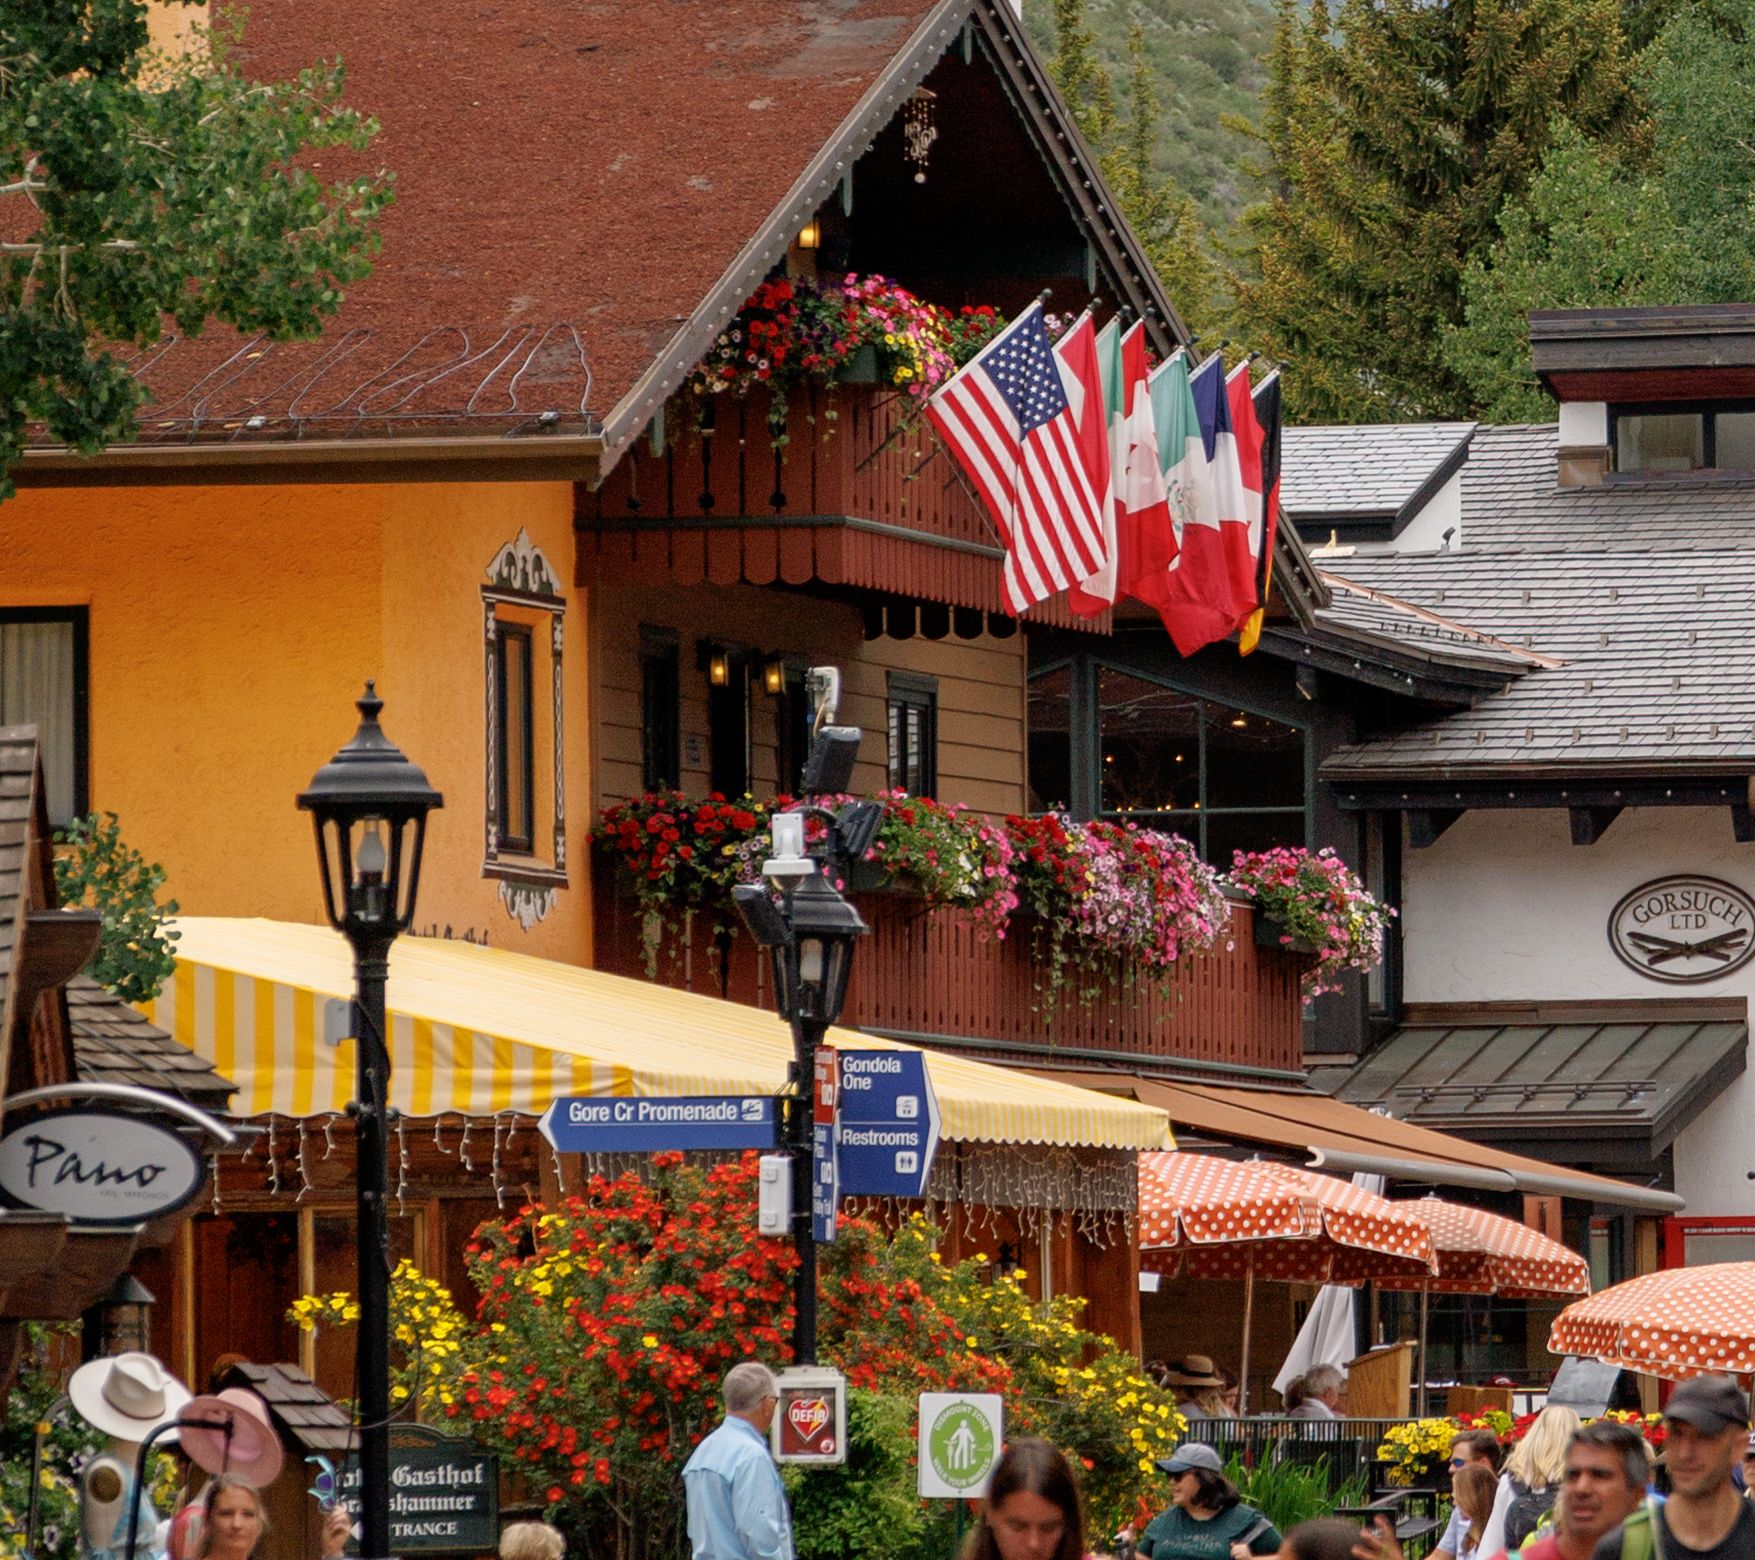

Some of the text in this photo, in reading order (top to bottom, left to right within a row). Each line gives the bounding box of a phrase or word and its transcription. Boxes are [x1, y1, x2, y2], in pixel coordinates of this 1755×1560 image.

[1632, 890, 1744, 927] GORSUCH
[1670, 913, 1707, 930] LTD
[842, 1056, 902, 1074] Gondola
[842, 1074, 872, 1091] One
[568, 1099, 737, 1122] Gore Cr Promenade
[842, 1129, 919, 1146] Restrooms
[792, 1408, 826, 1422] DEFIB
[391, 1521, 458, 1537] TRANCE
